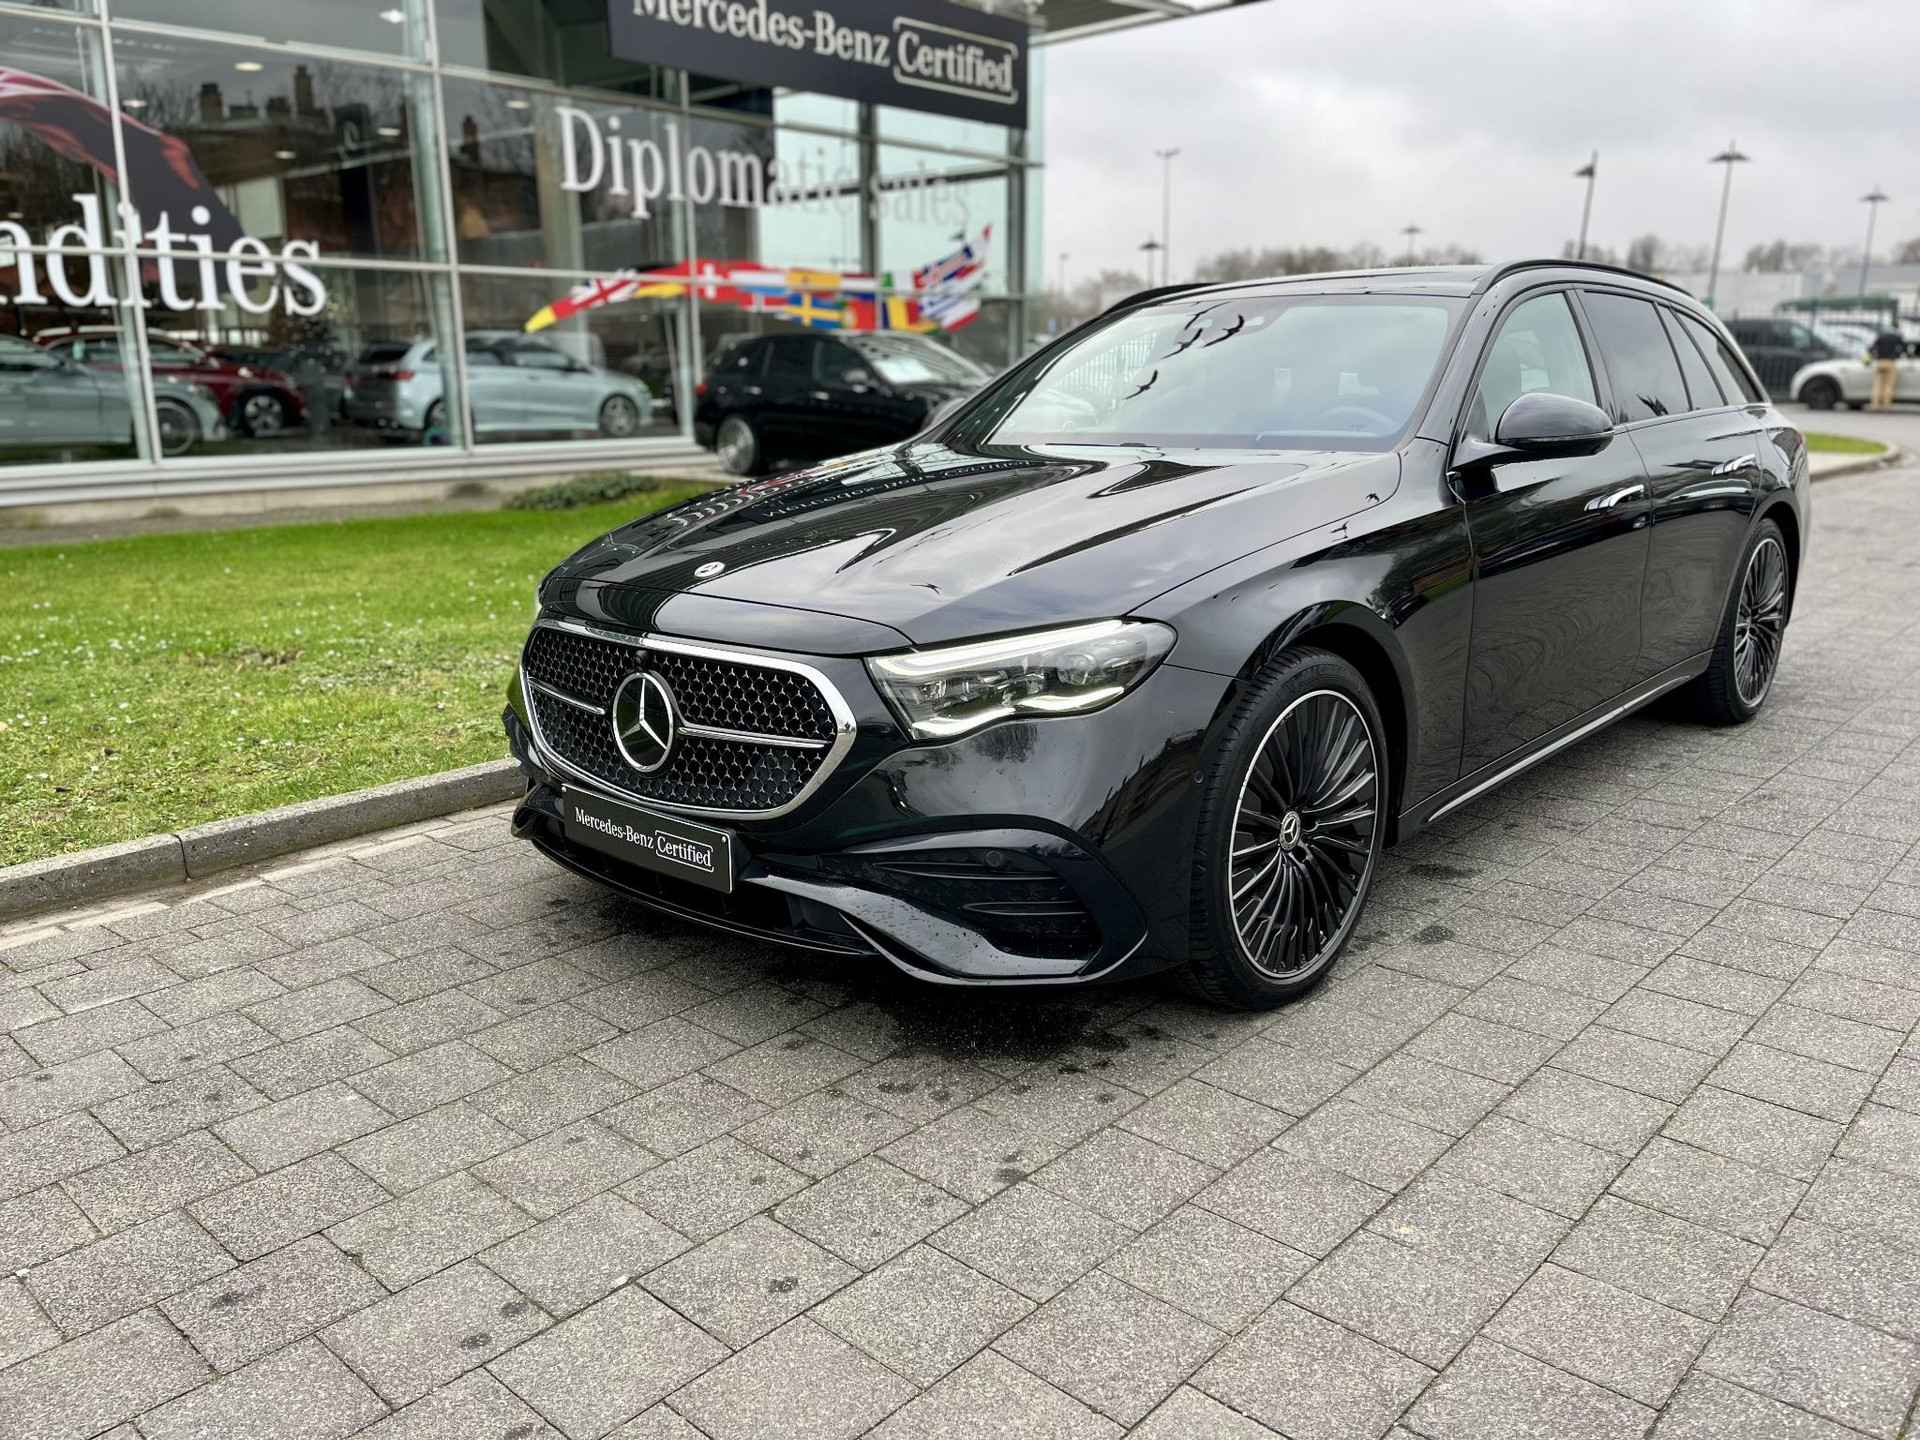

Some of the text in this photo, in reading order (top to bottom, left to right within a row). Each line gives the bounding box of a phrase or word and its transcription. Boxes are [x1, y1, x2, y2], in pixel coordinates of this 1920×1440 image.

[899, 30, 1013, 93] Certified
[556, 106, 852, 219] Diplomatic
[574, 806, 712, 867] Mercedes-Benz Certified
